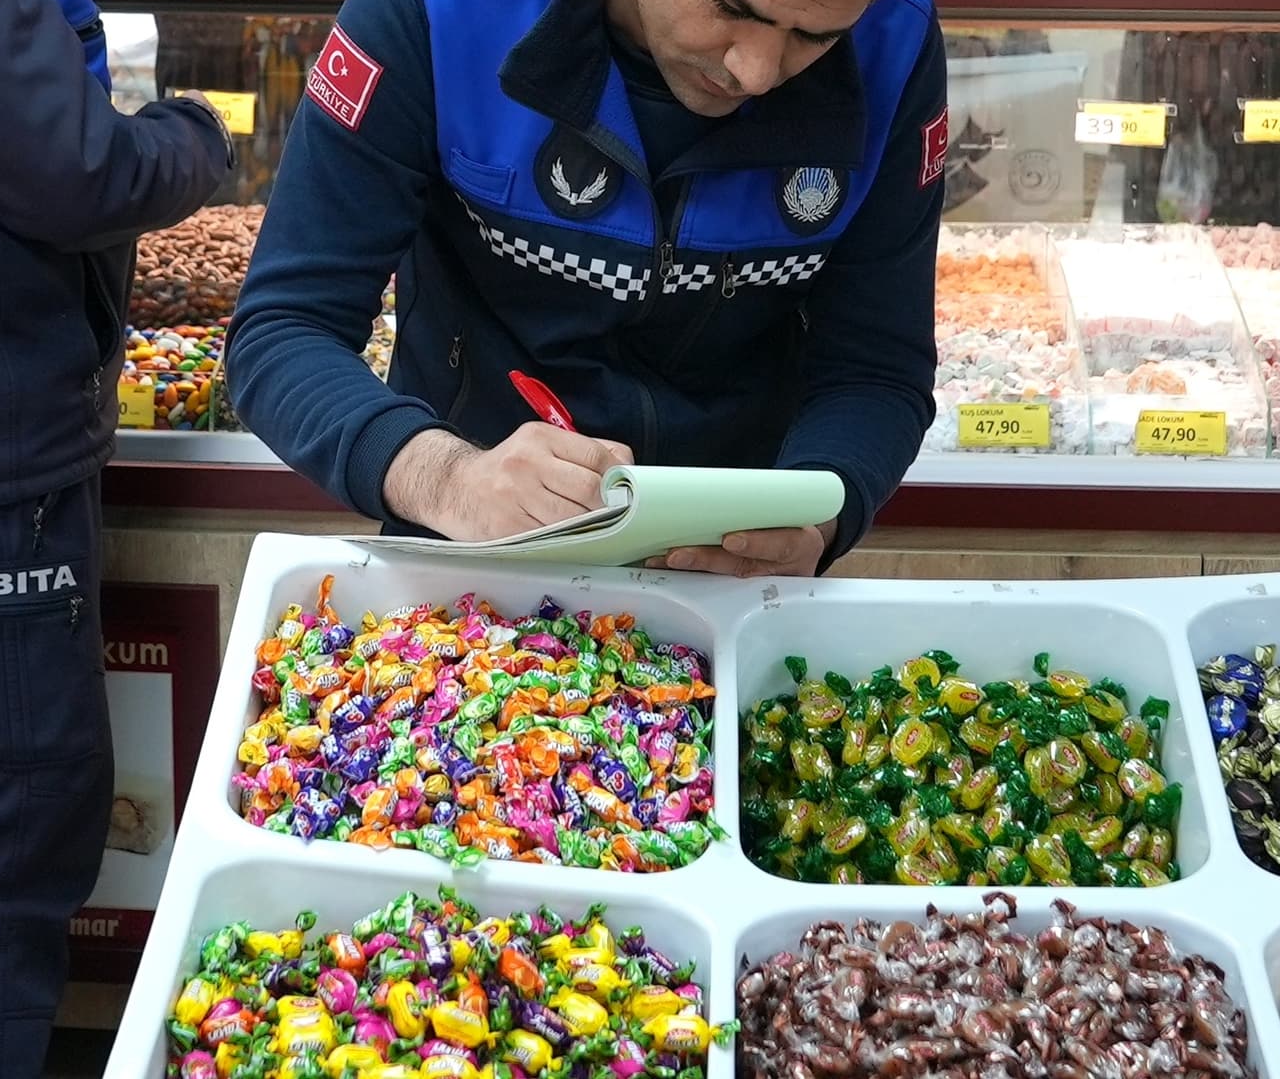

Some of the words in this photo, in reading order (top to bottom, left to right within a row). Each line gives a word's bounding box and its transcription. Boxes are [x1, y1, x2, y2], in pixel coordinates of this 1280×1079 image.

[310, 73, 350, 118] TÜRKİYE
[976, 409, 1004, 417] LOKUM
[976, 420, 1020, 436] 47,90
[1152, 428, 1196, 444] 47,90
[102, 636, 169, 666] kum
